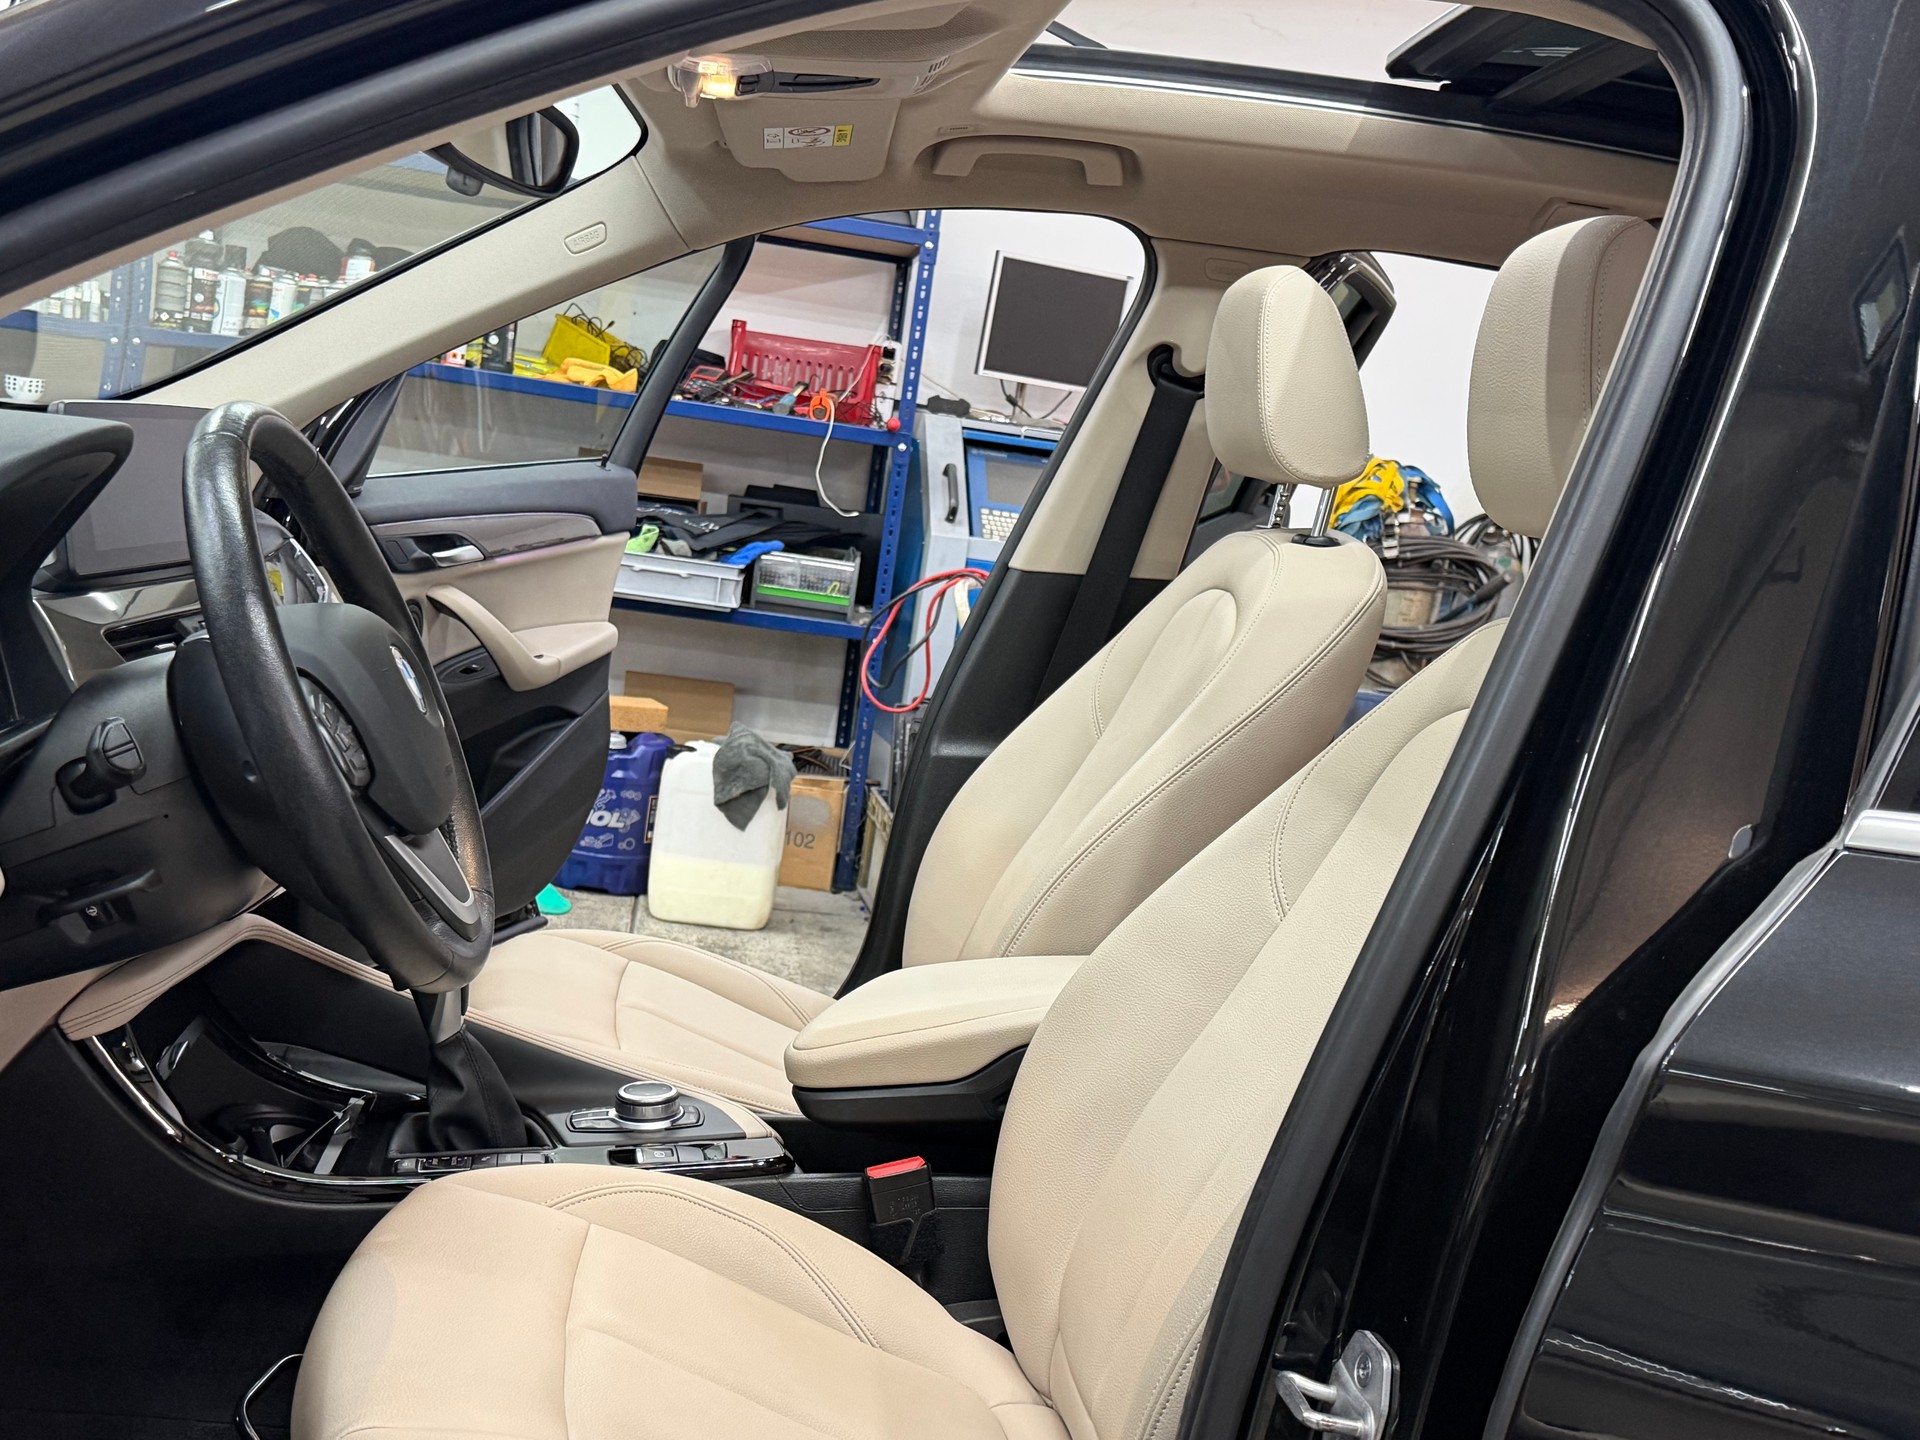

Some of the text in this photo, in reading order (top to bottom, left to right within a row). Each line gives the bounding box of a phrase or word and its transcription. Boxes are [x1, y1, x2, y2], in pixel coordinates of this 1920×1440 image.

[573, 230, 599, 247] AIRBAG
[586, 809, 625, 828] OL
[786, 831, 816, 849] 102
